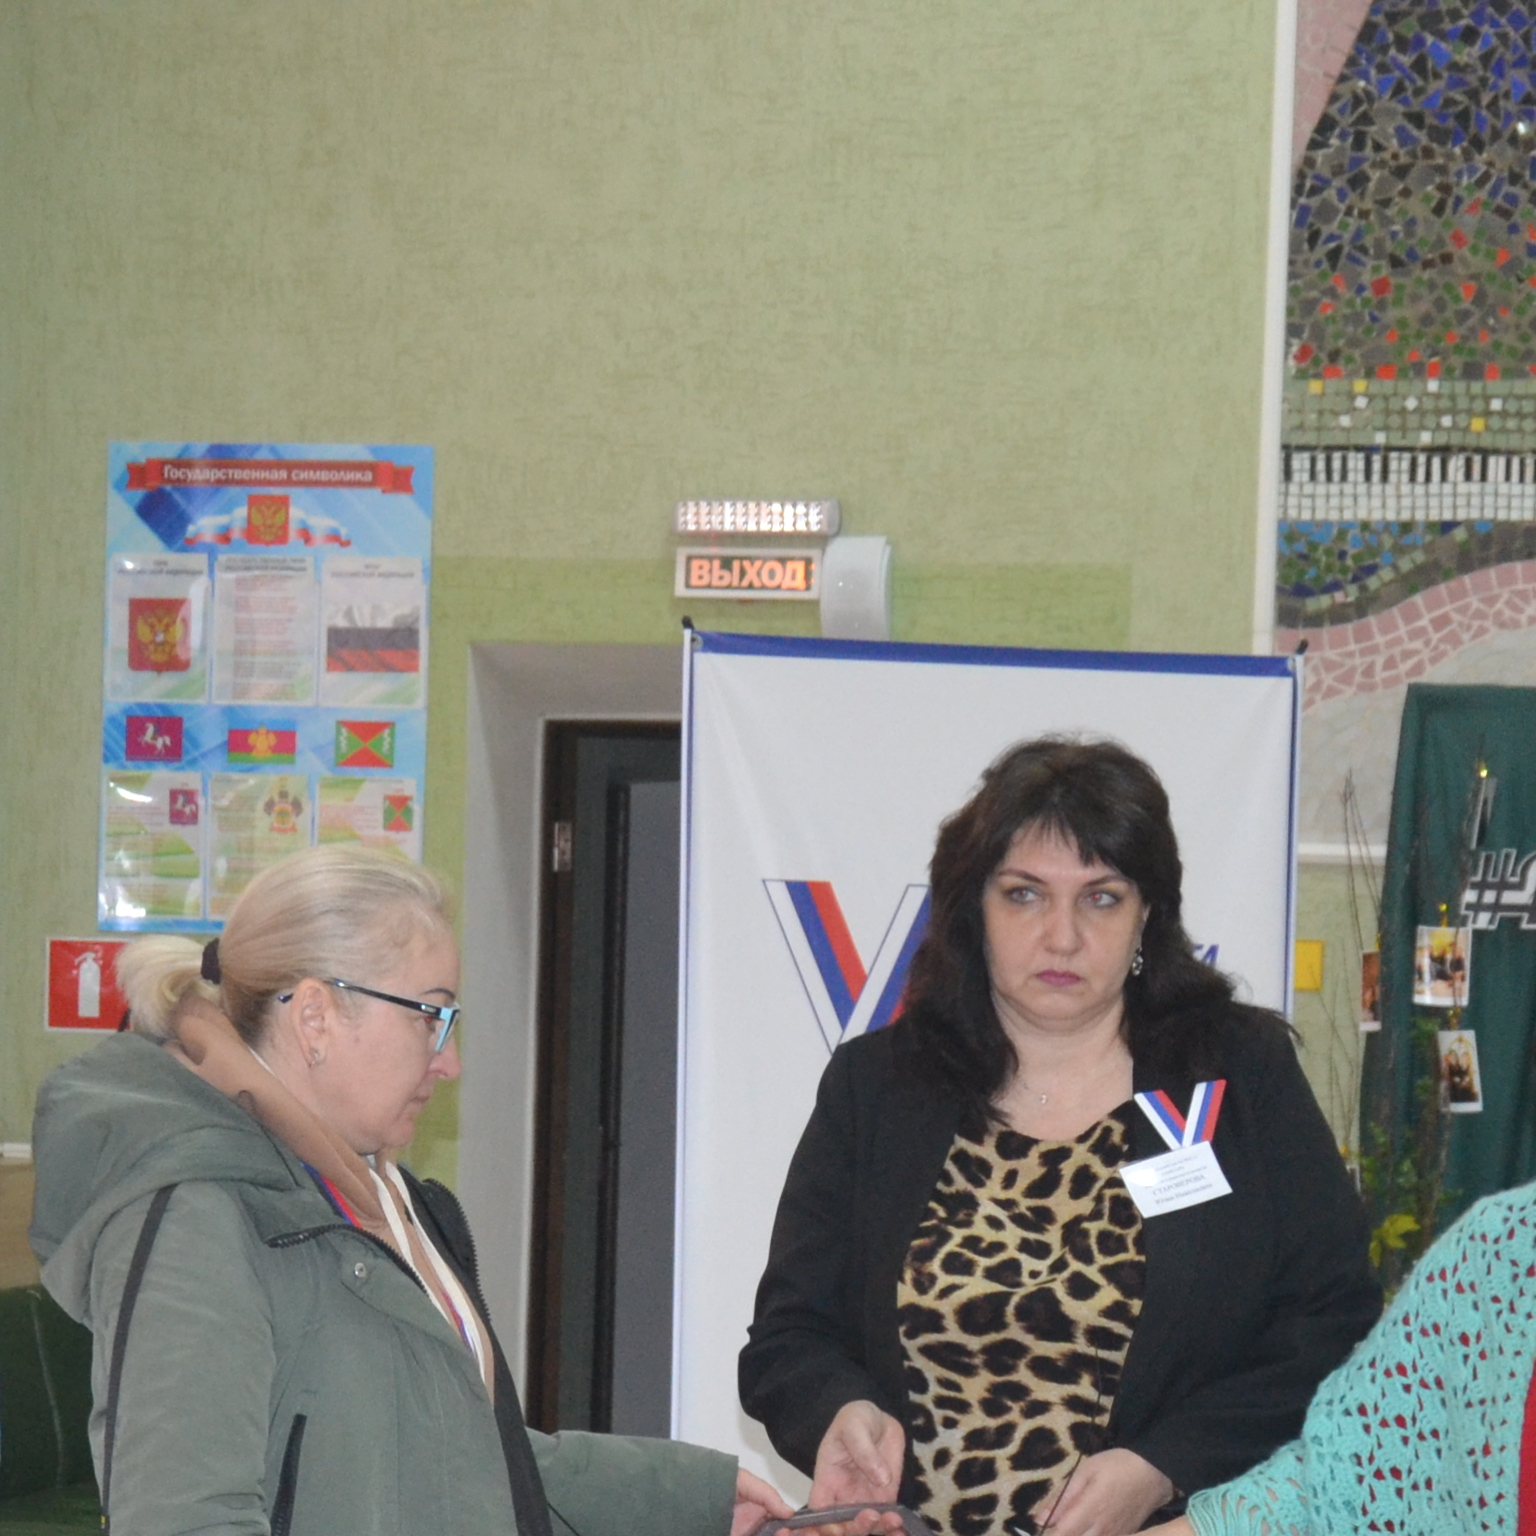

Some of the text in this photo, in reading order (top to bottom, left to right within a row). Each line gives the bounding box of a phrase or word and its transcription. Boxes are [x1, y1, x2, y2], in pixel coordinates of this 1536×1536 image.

[163, 464, 373, 485] Государственная символика
[690, 558, 806, 591] ВЫХОД
